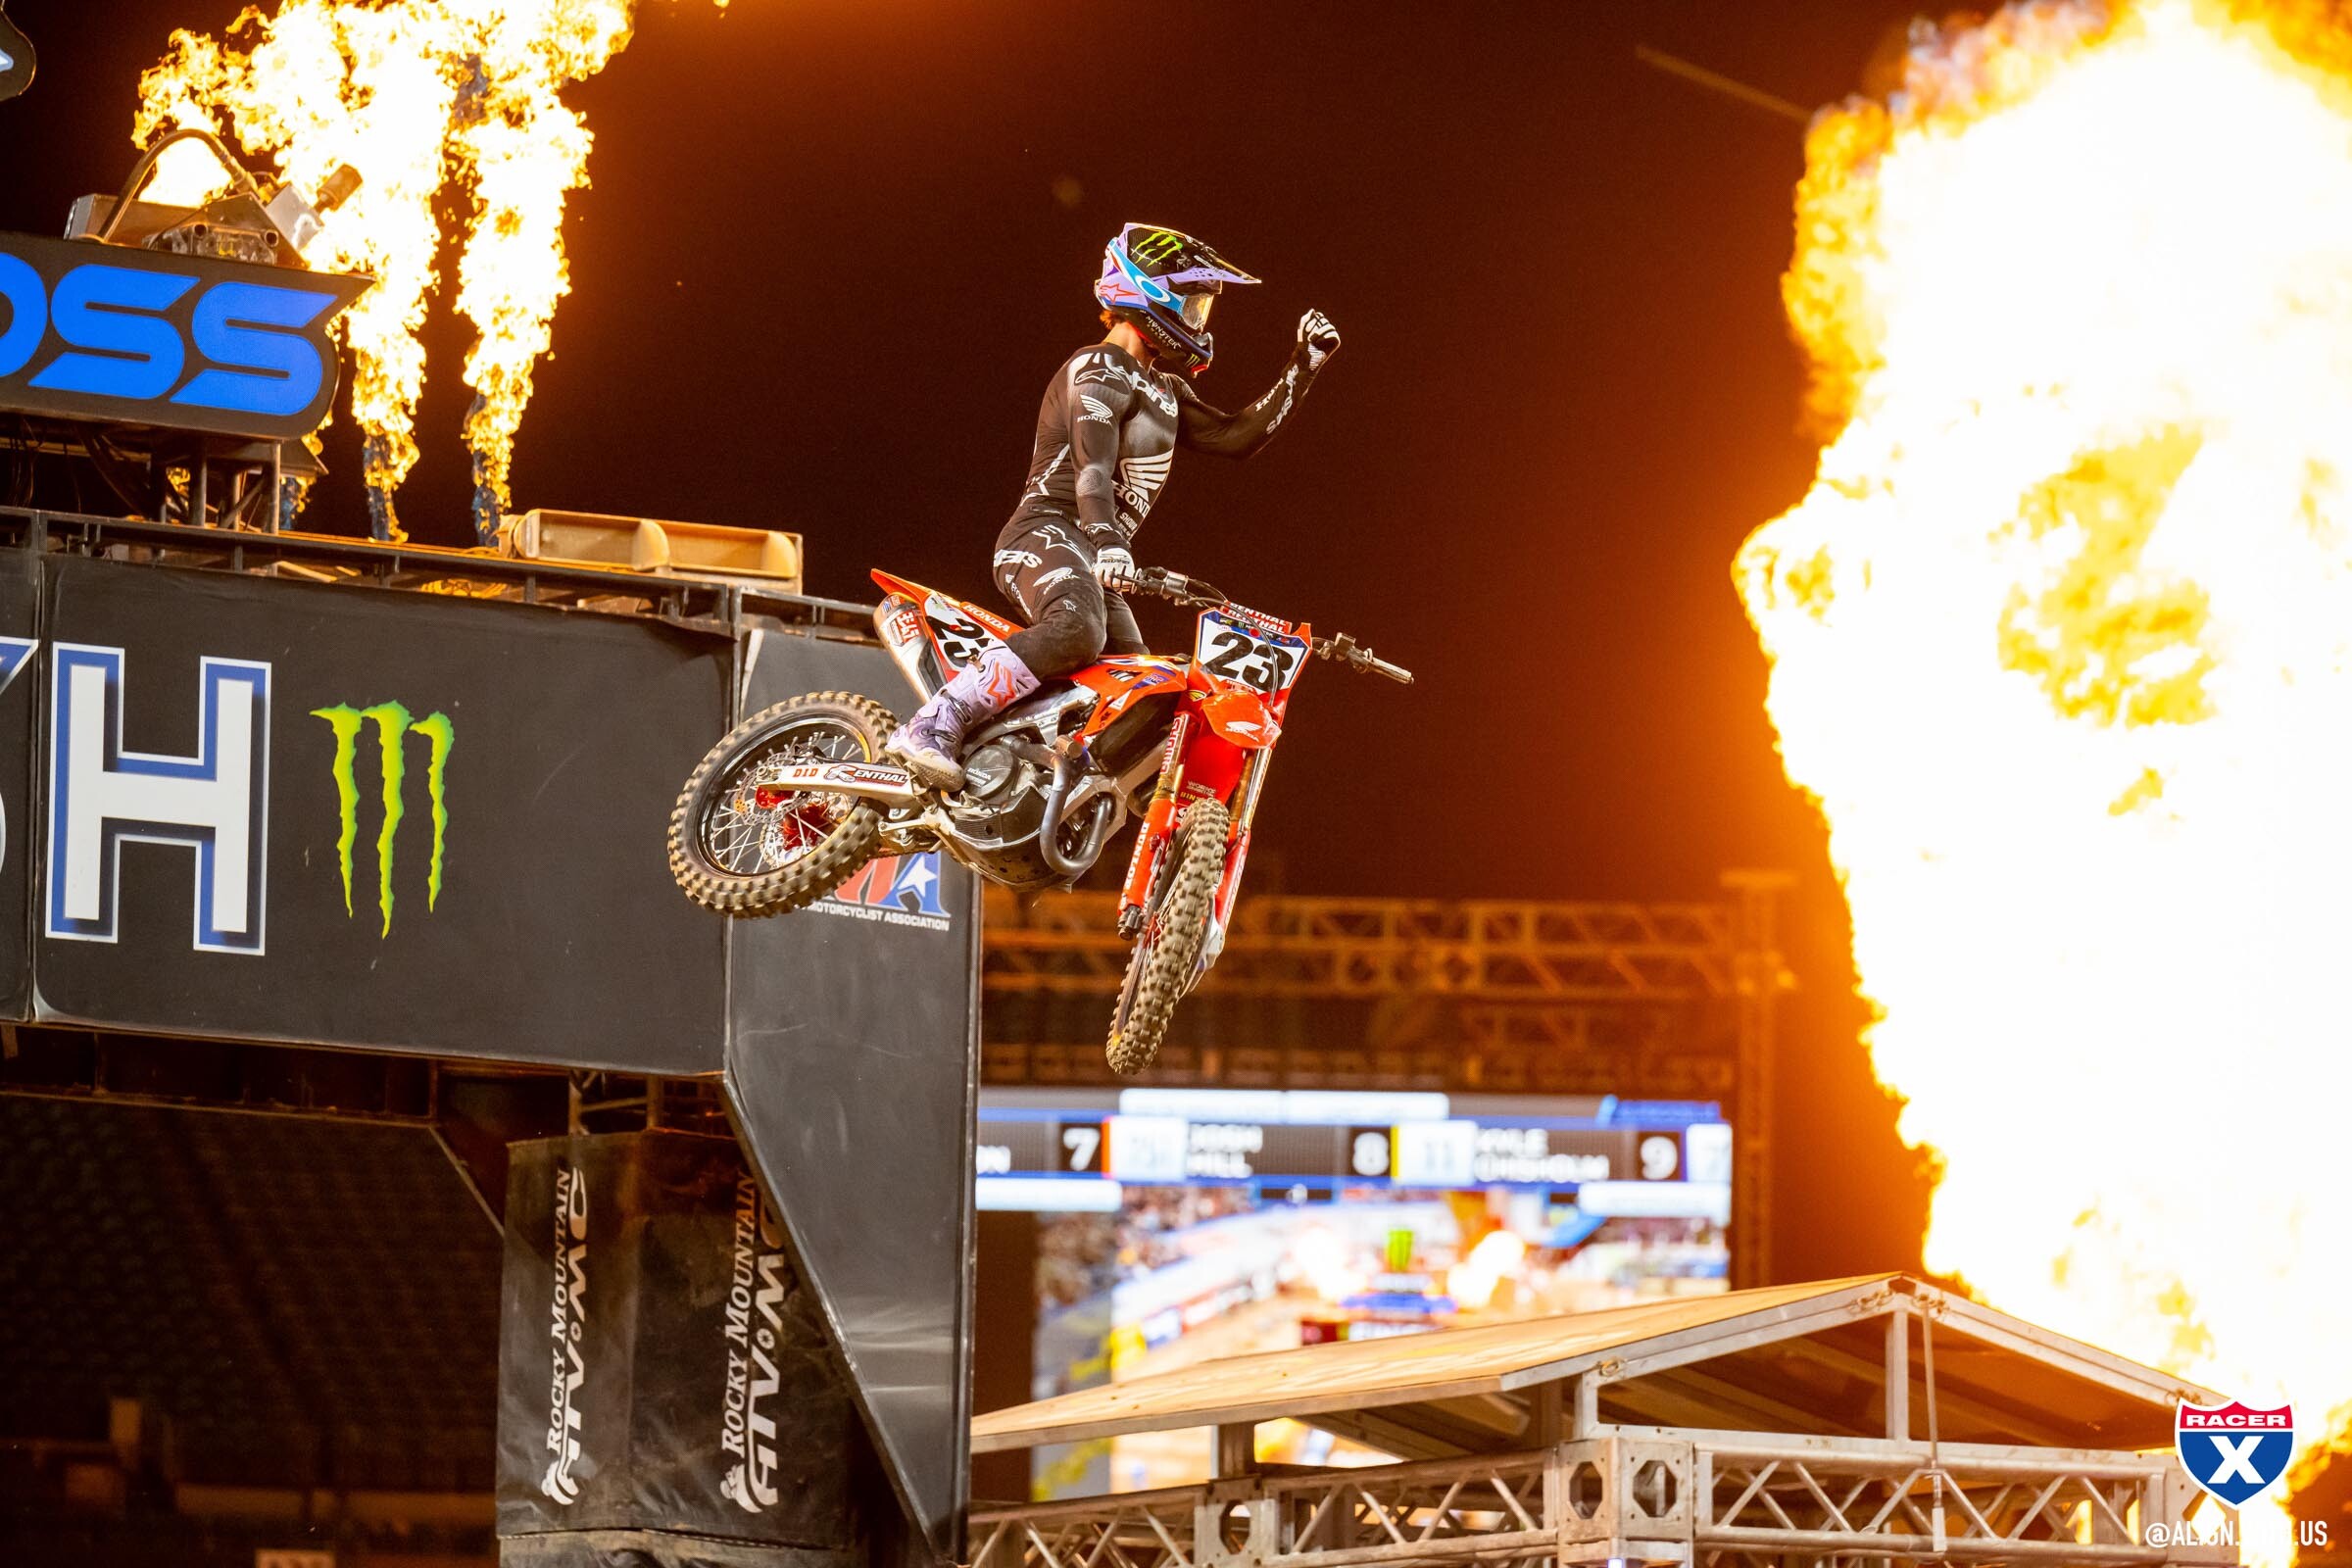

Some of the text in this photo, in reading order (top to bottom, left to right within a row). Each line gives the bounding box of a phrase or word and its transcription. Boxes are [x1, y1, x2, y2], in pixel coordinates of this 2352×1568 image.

[962, 604, 1011, 632] HONDA
[1202, 631, 1294, 693] 23
[884, 910, 951, 932] ASSOCIATION
[1063, 1128, 1101, 1172] 7
[1352, 1132, 1390, 1176] 8
[1641, 1136, 1679, 1181] 9
[546, 1169, 571, 1454] ROCKY MOUNTAIN
[721, 1174, 756, 1459] ROCKY MOUNTAIN
